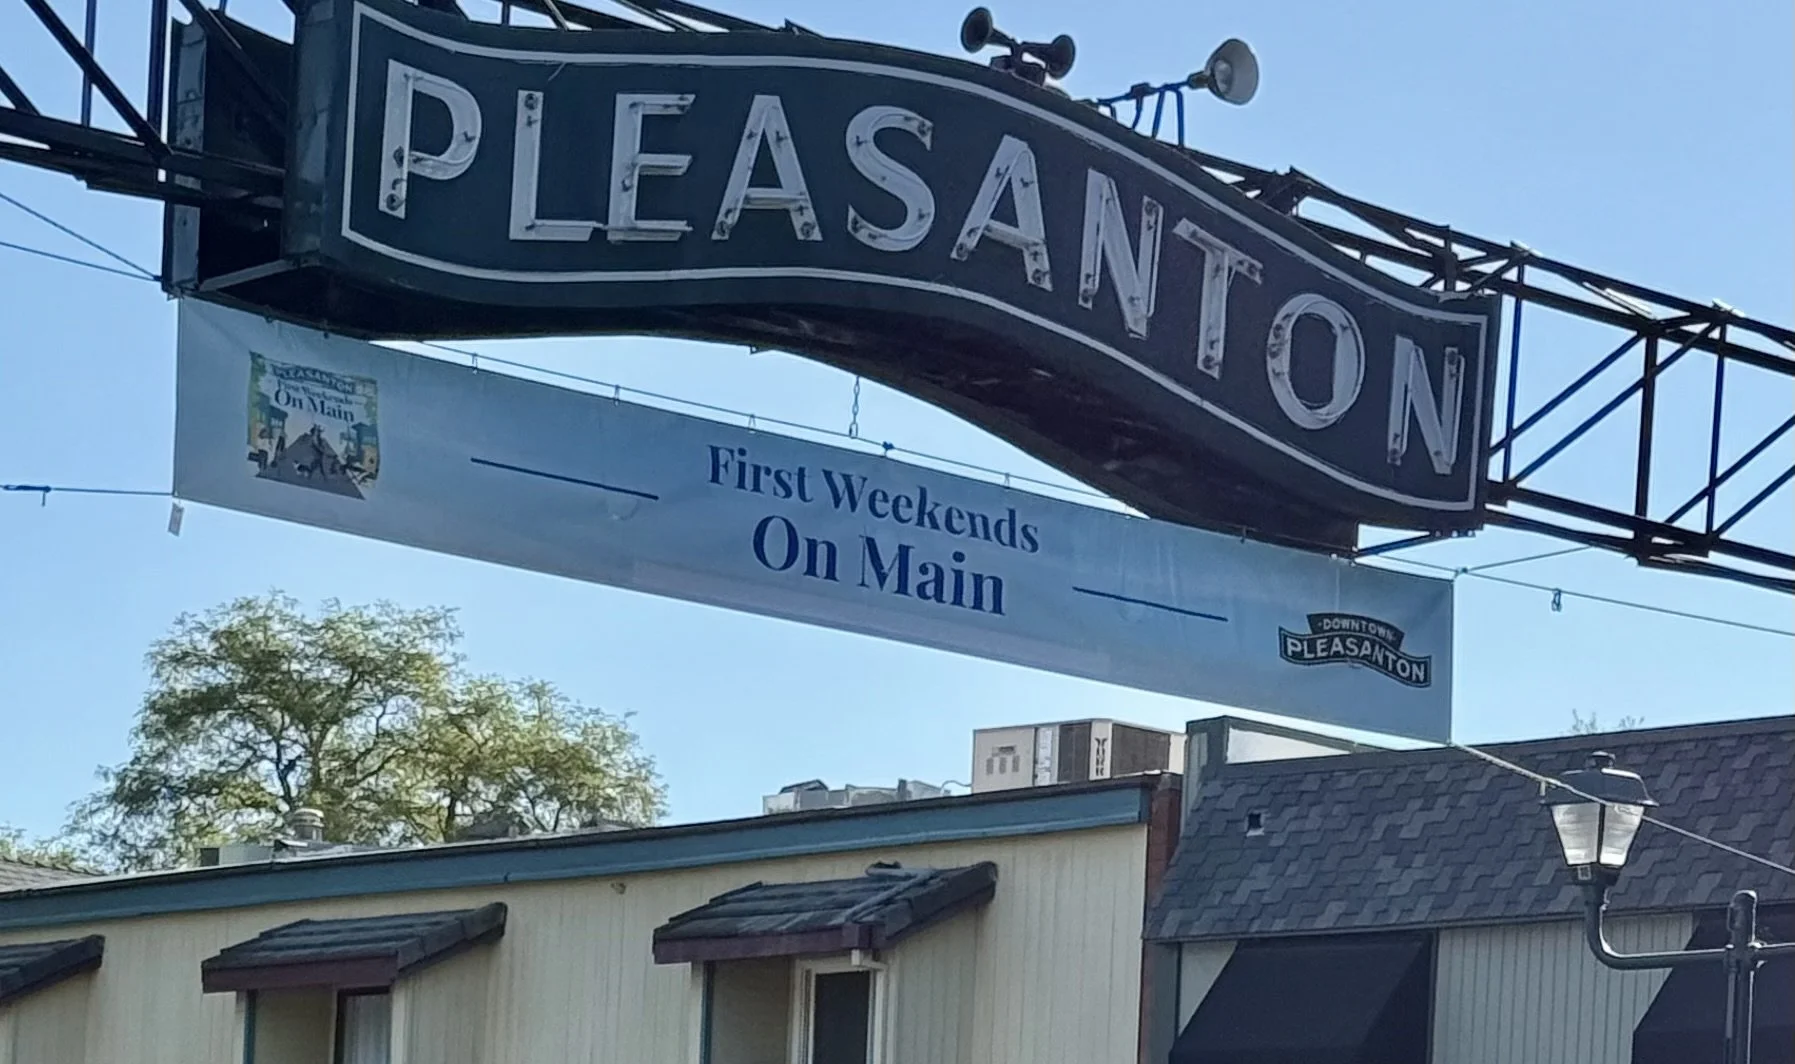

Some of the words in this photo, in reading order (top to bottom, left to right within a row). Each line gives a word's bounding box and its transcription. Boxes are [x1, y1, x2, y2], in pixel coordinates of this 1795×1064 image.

[378, 60, 1465, 476] PLEASANTON
[275, 390, 303, 410] On
[307, 396, 355, 422] Main
[708, 444, 814, 503] First
[822, 468, 1040, 554] Weekends
[752, 514, 840, 583] On
[857, 533, 1006, 616] Main
[1286, 637, 1425, 682] PLEASANTON
[1322, 617, 1395, 640] DOWNTOWN
